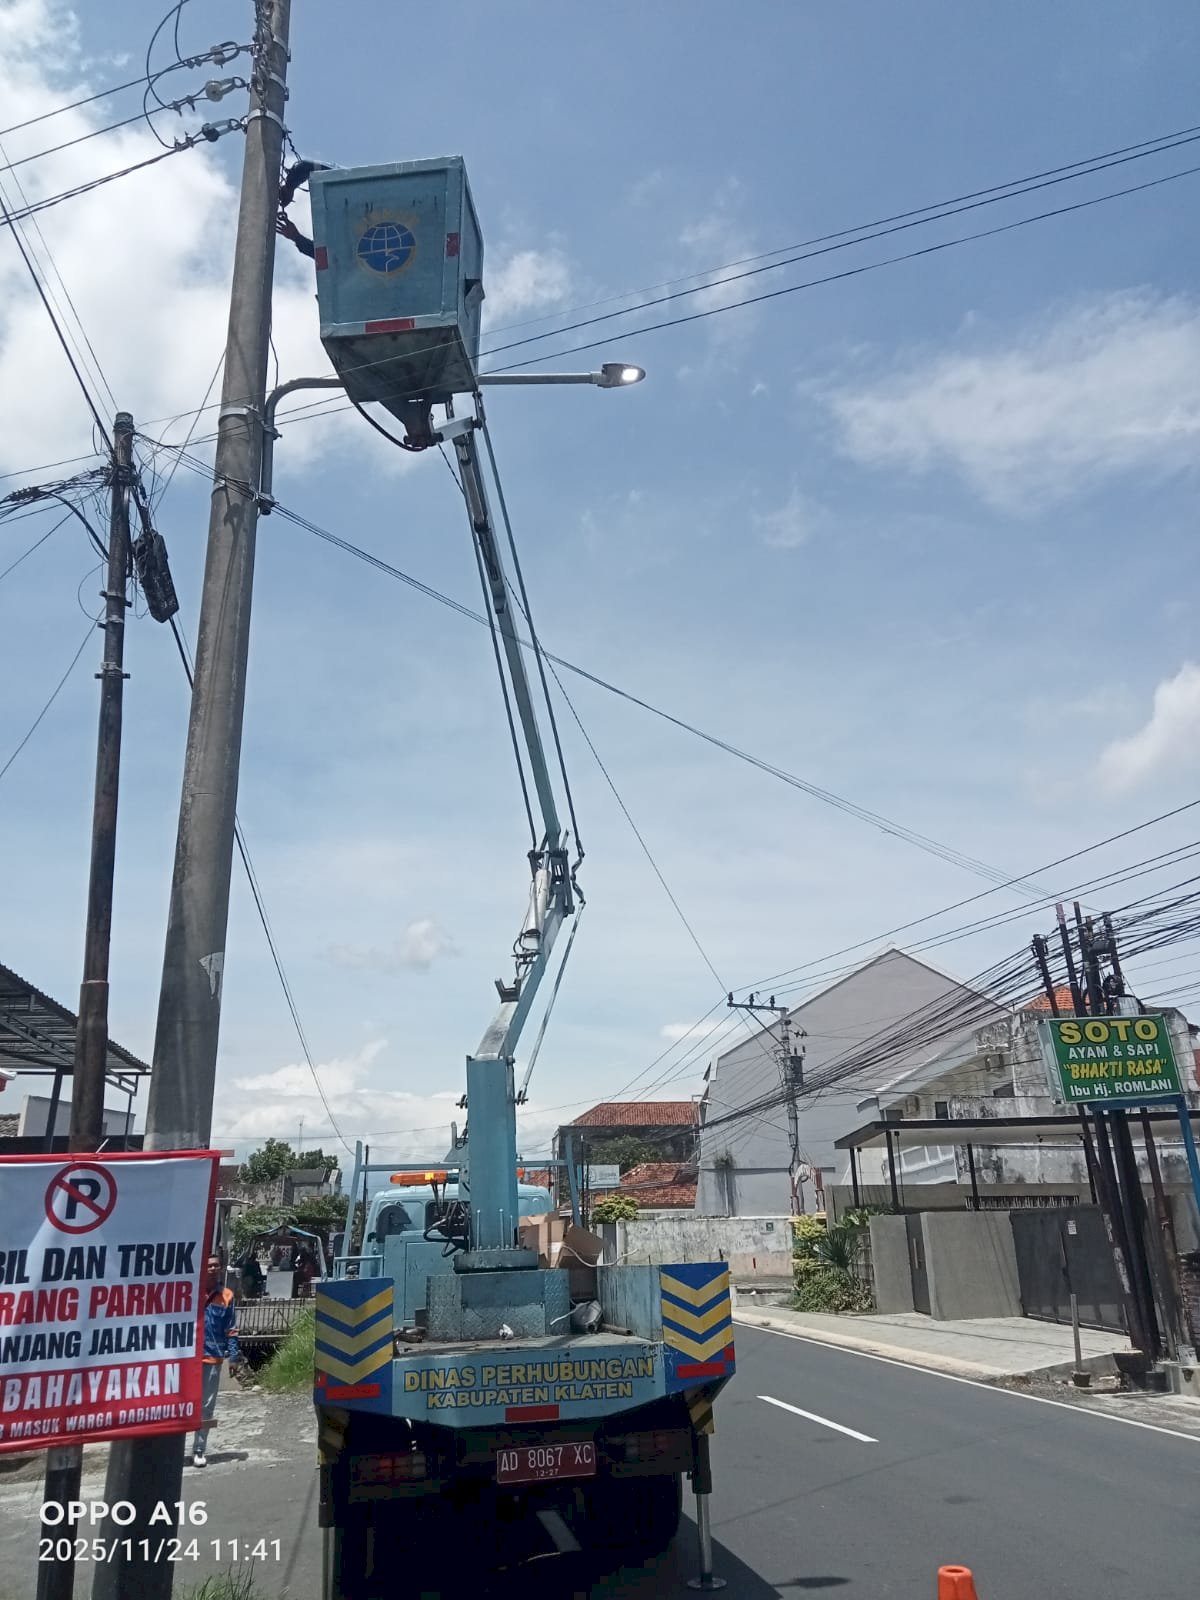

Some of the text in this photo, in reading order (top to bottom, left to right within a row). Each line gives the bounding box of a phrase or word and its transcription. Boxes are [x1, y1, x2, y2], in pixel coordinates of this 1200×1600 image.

[1060, 1019, 1158, 1044] SOTO
[1069, 1043, 1159, 1060] AYAM & SAPI
[1070, 1079, 1172, 1097] Ibu Hj. ROMLANI
[41, 1245, 107, 1282] DAN
[117, 1241, 197, 1277] TRUK
[88, 1280, 194, 1319] PARKIR
[0, 1320, 195, 1364] NJANG JALAN INI
[0, 1363, 180, 1412] BAHAYAKAN
[404, 1356, 655, 1393] DINAS PERHUBUNGAN
[427, 1381, 633, 1410] KABUPATEN KLATEN
[10, 1417, 60, 1438] MASUK
[65, 1412, 113, 1432] WARGA
[119, 1402, 194, 1425] DADIMULYO
[501, 1445, 592, 1472] AD 8067 XC
